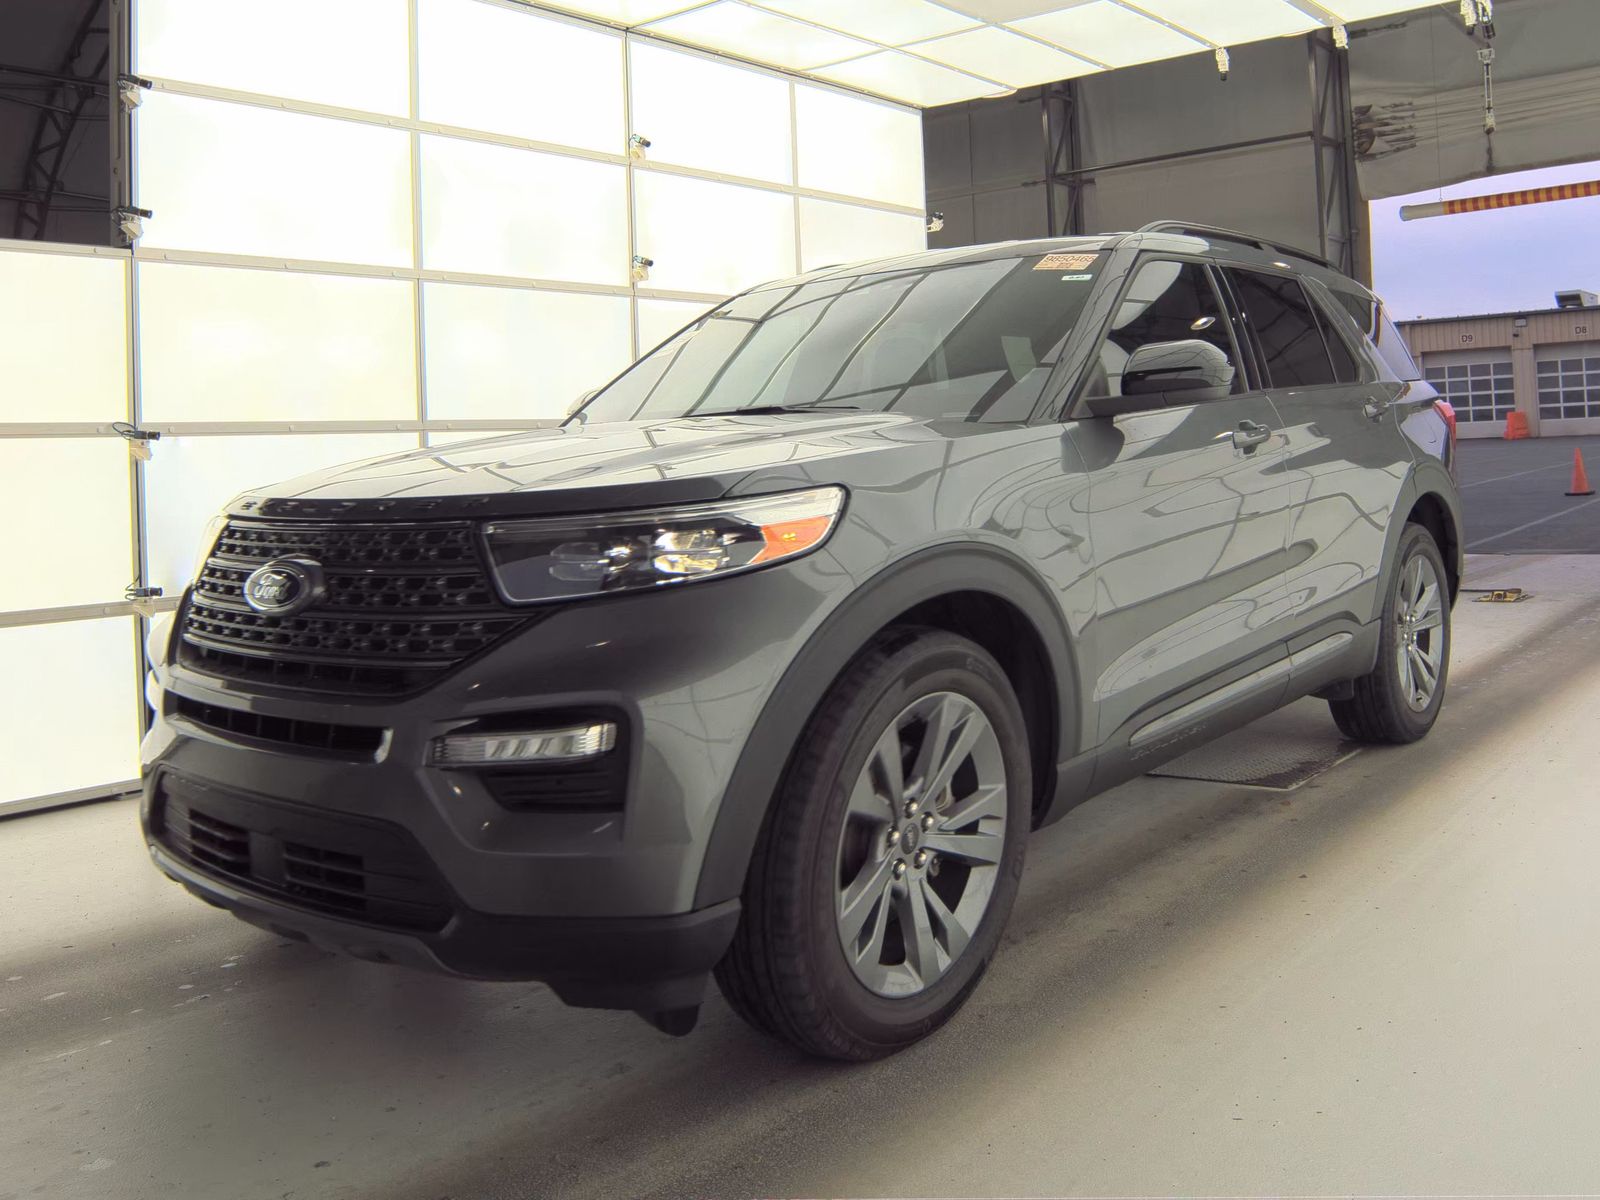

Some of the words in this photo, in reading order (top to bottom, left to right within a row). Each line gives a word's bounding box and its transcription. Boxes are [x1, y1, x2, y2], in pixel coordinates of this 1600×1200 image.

[1575, 326, 1587, 335] D8
[1461, 334, 1473, 343] D9
[253, 573, 292, 599] Ford
